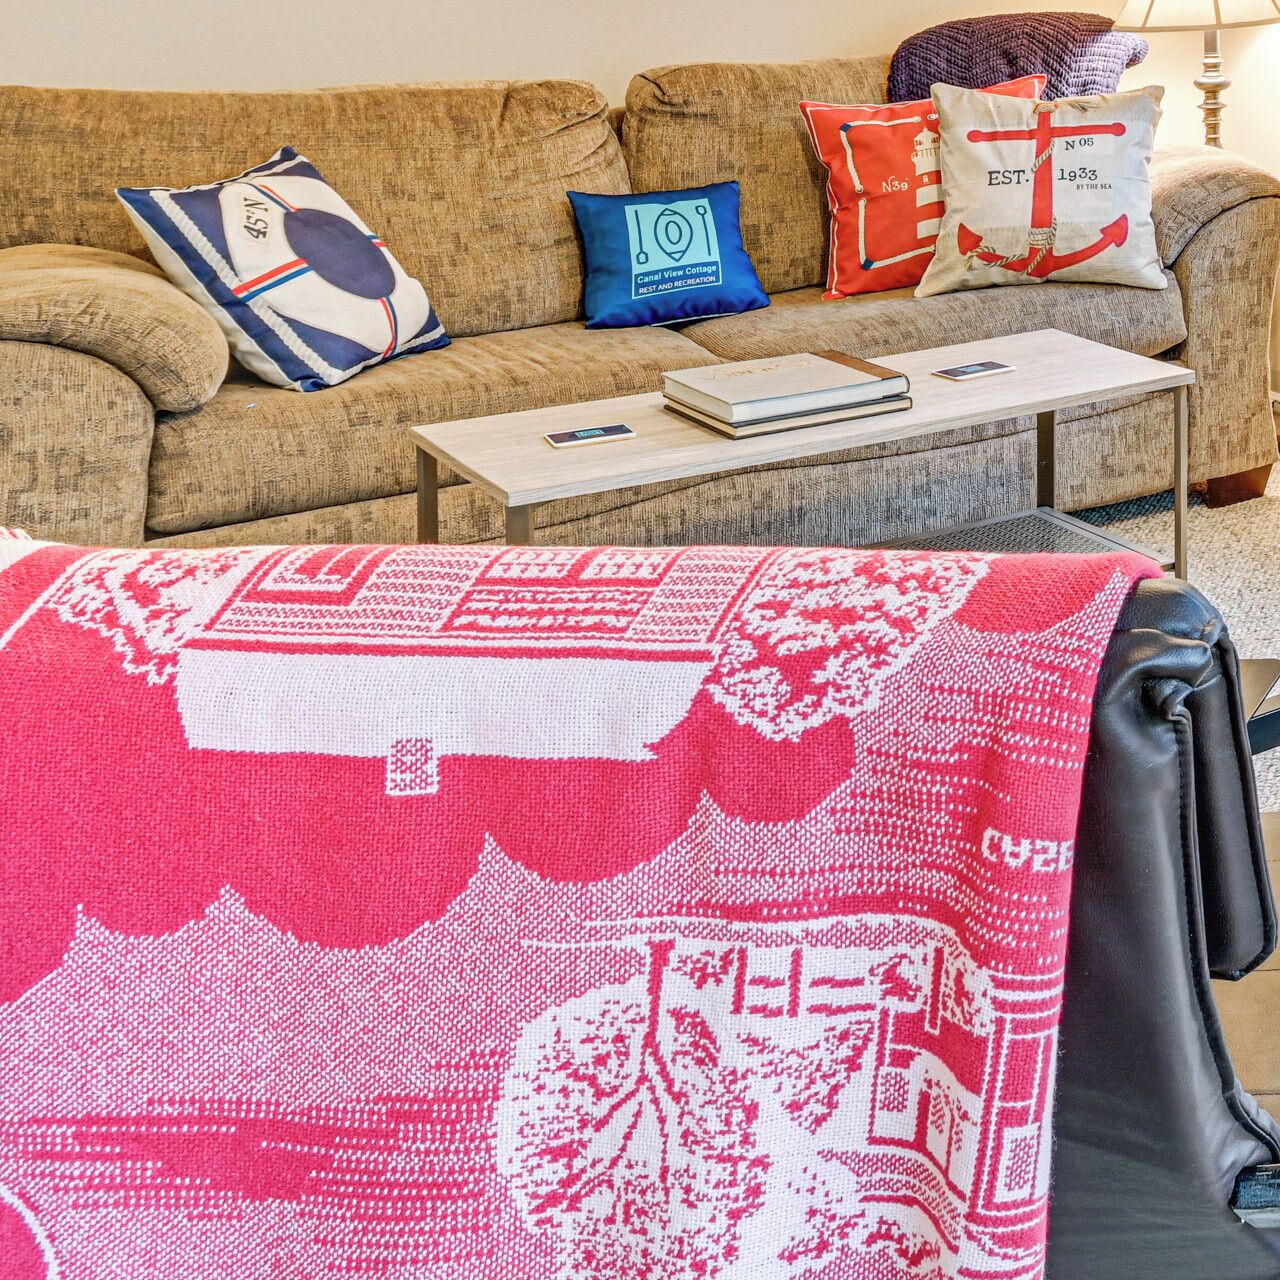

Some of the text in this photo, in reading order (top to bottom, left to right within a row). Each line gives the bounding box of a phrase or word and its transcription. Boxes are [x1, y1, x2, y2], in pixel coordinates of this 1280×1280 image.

[987, 166, 1099, 187] EST. 1933
[1076, 183, 1084, 191] BY
[1100, 182, 1113, 190] SEA
[637, 264, 717, 284] Canal View Cottage
[639, 276, 716, 294] REST AND RECREATION
